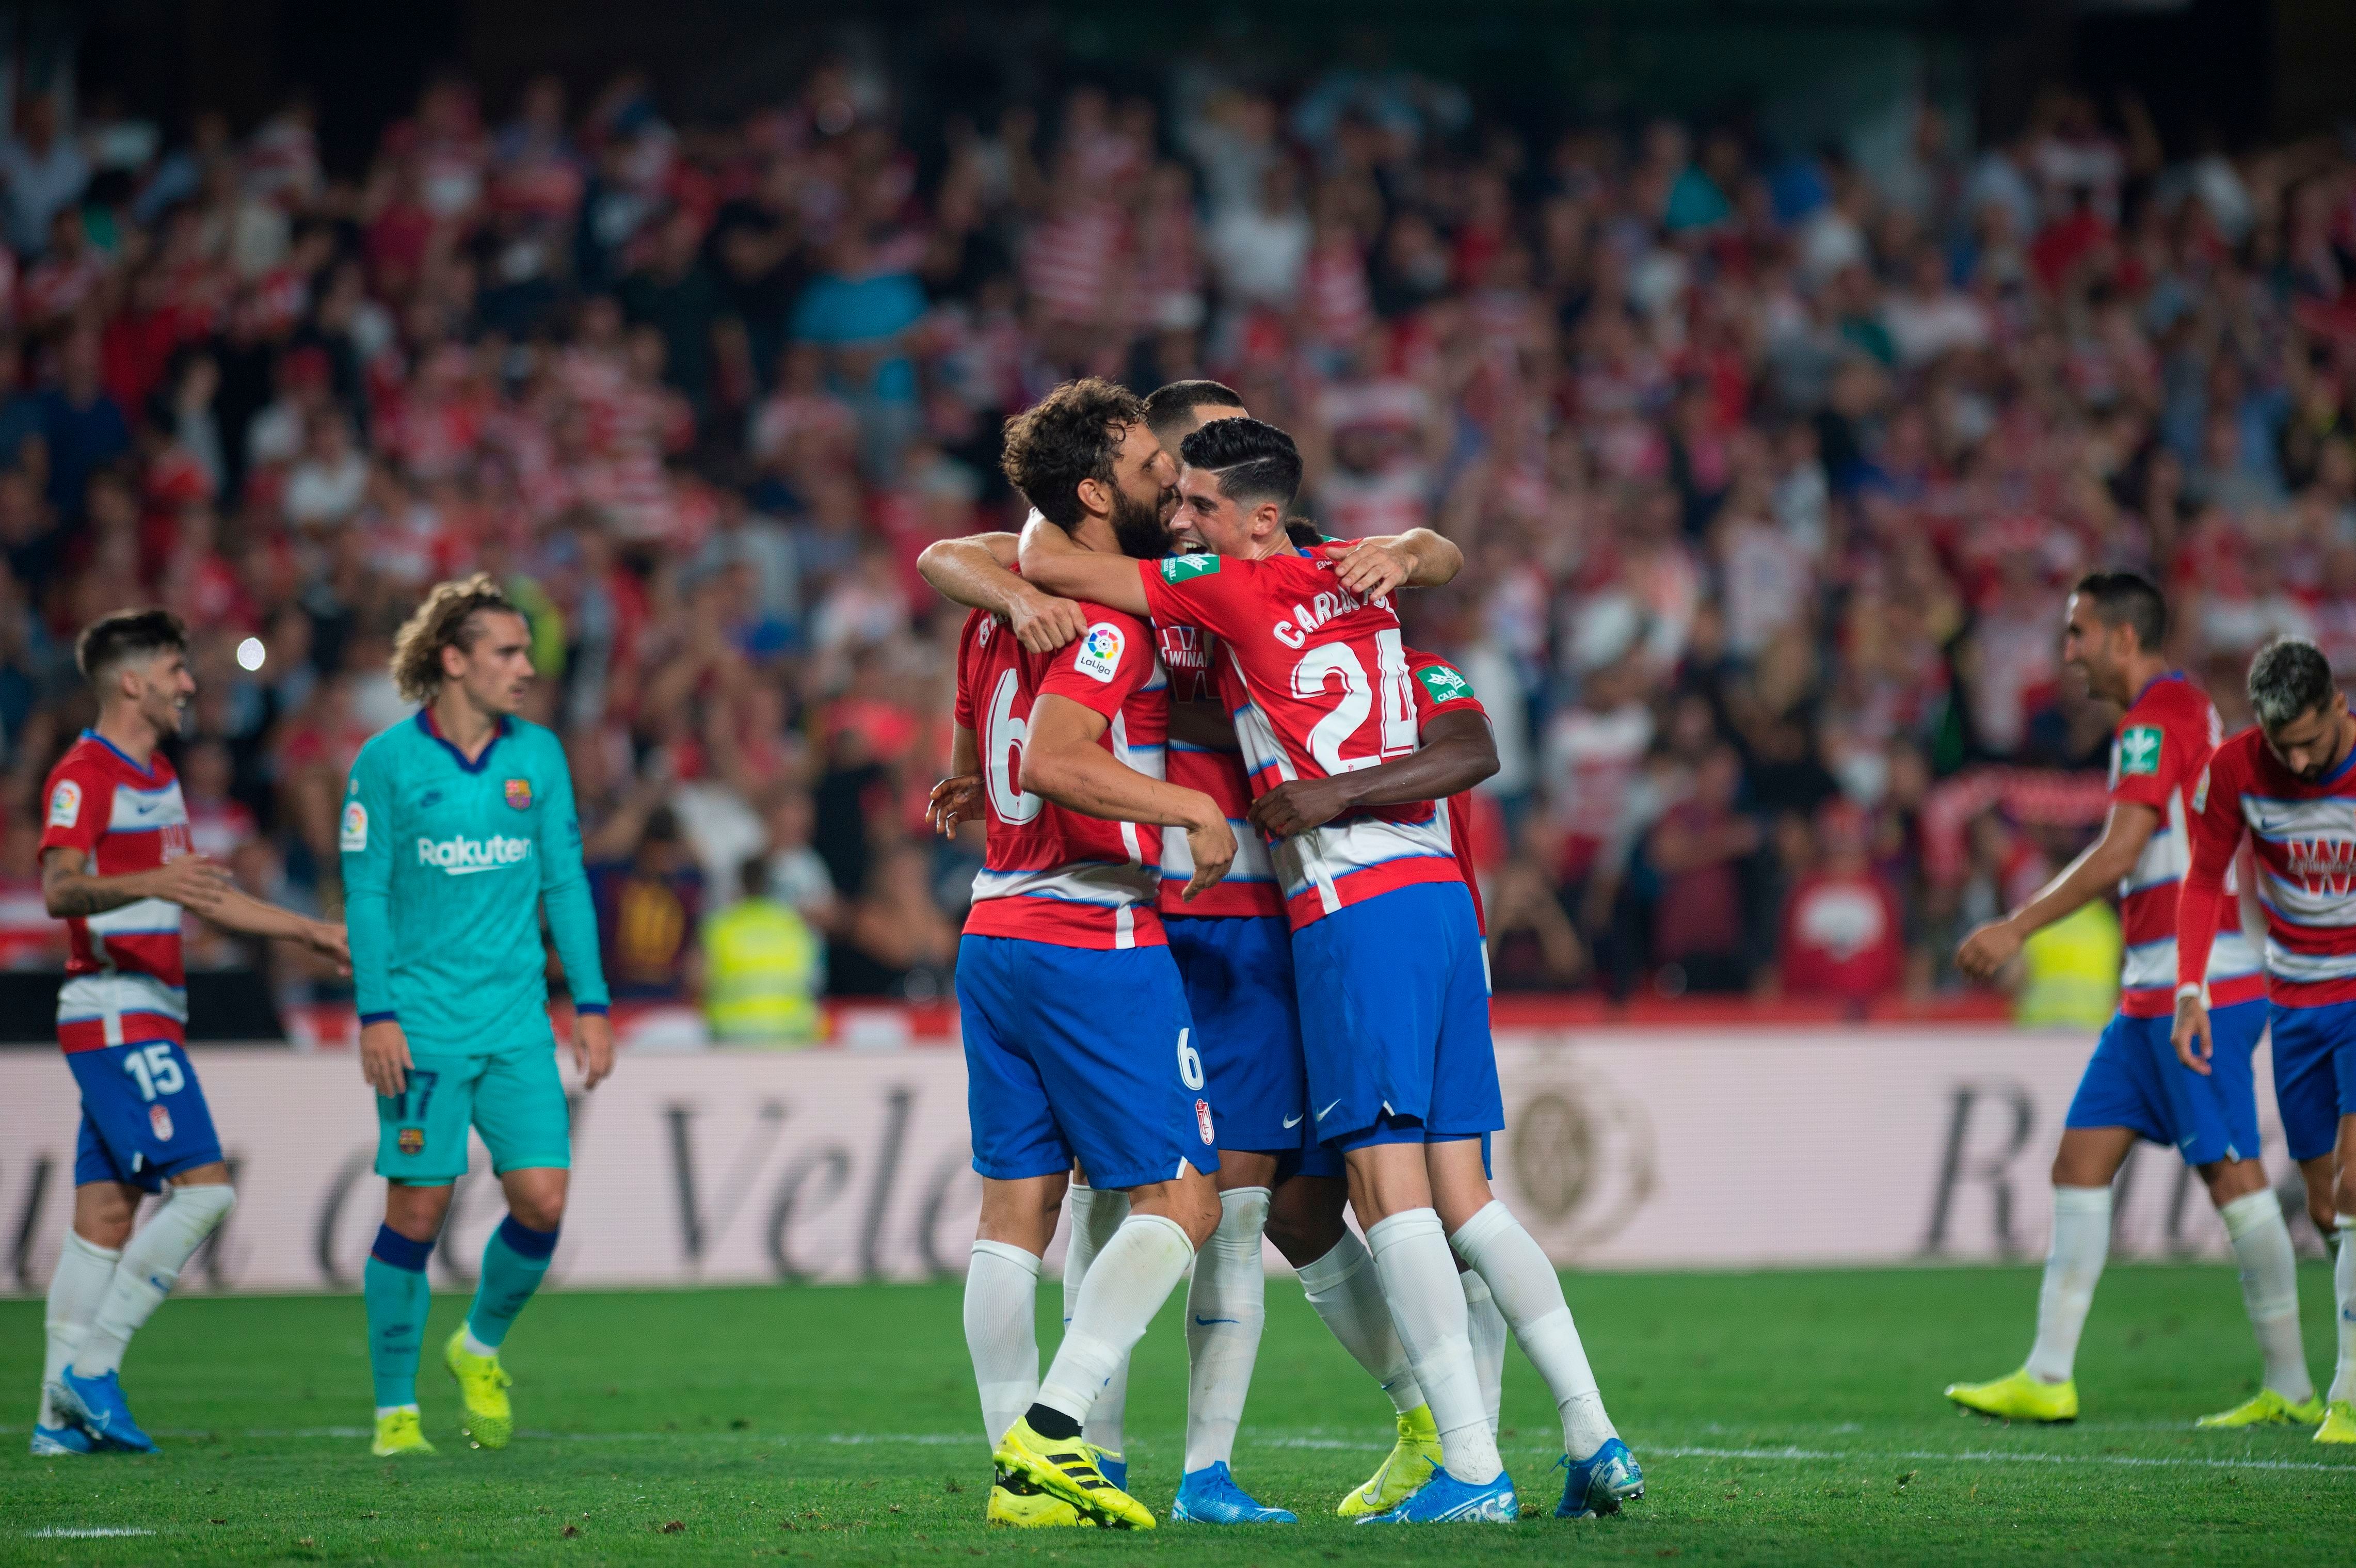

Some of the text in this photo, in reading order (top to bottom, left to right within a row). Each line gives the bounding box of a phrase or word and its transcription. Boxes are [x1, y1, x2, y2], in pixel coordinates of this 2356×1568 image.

[1081, 657, 1111, 676] LaLiga
[1169, 651, 1208, 667] WINA
[1290, 628, 1421, 777] 24
[985, 668, 1044, 826] 6
[123, 1044, 185, 1103] 15
[1177, 1028, 1204, 1091] 6
